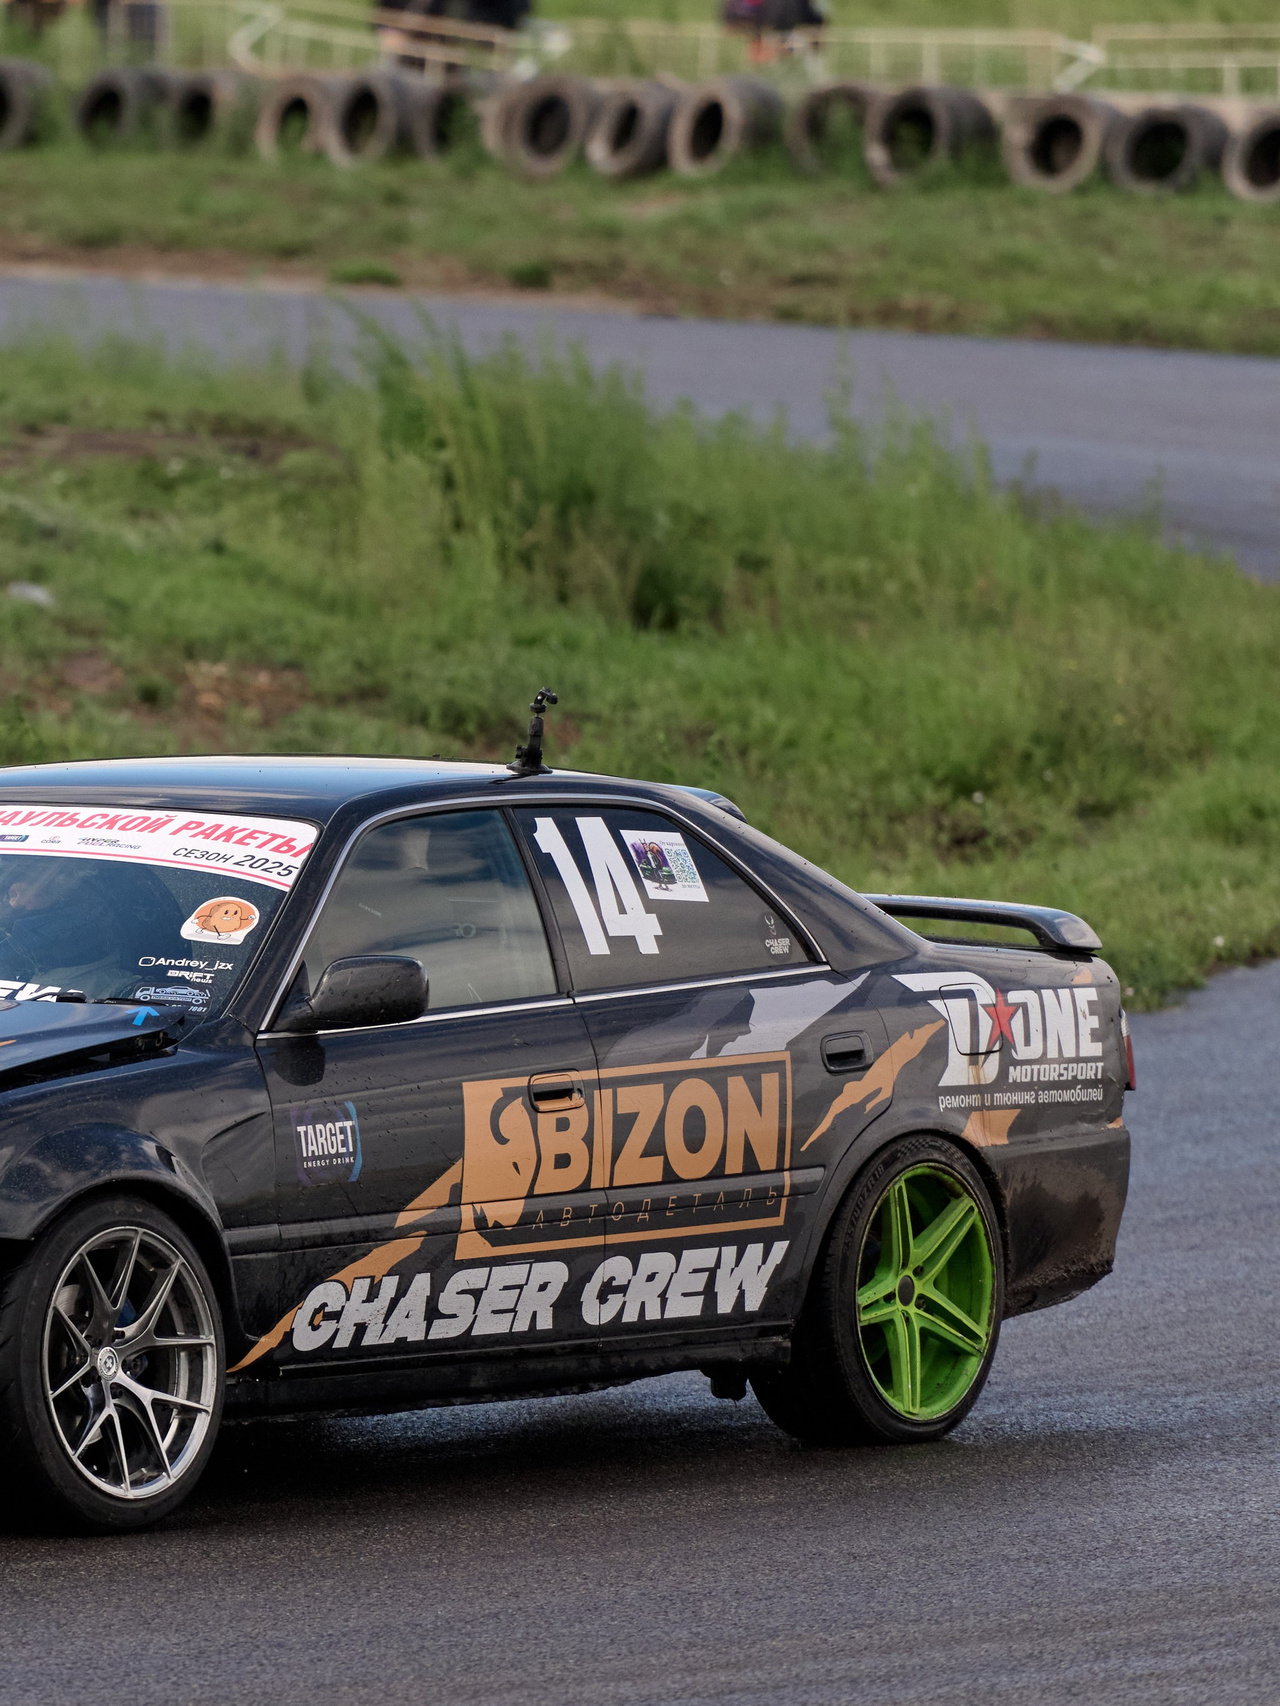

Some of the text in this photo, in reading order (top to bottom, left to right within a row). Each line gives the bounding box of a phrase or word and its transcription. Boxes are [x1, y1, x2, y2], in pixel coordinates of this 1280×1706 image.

[169, 820, 314, 858] РАКЕТЫ
[173, 847, 299, 877] СЕЗОН 2025
[533, 817, 663, 955] 14
[765, 938, 790, 947] CHASER
[770, 946, 789, 954] CREW
[155, 957, 234, 970] Andrey_jzx
[1008, 1062, 1104, 1083] MOTORSPORT
[938, 1084, 1104, 1113] ремонт и тюнинг автомобилей
[296, 1120, 355, 1157] TARGET
[534, 1072, 780, 1194] BIZON
[303, 1156, 355, 1168] ENERGY DRINK
[531, 1186, 779, 1230] АВТОДЕТАЛЬ
[291, 1240, 790, 1352] CHASER CREW
